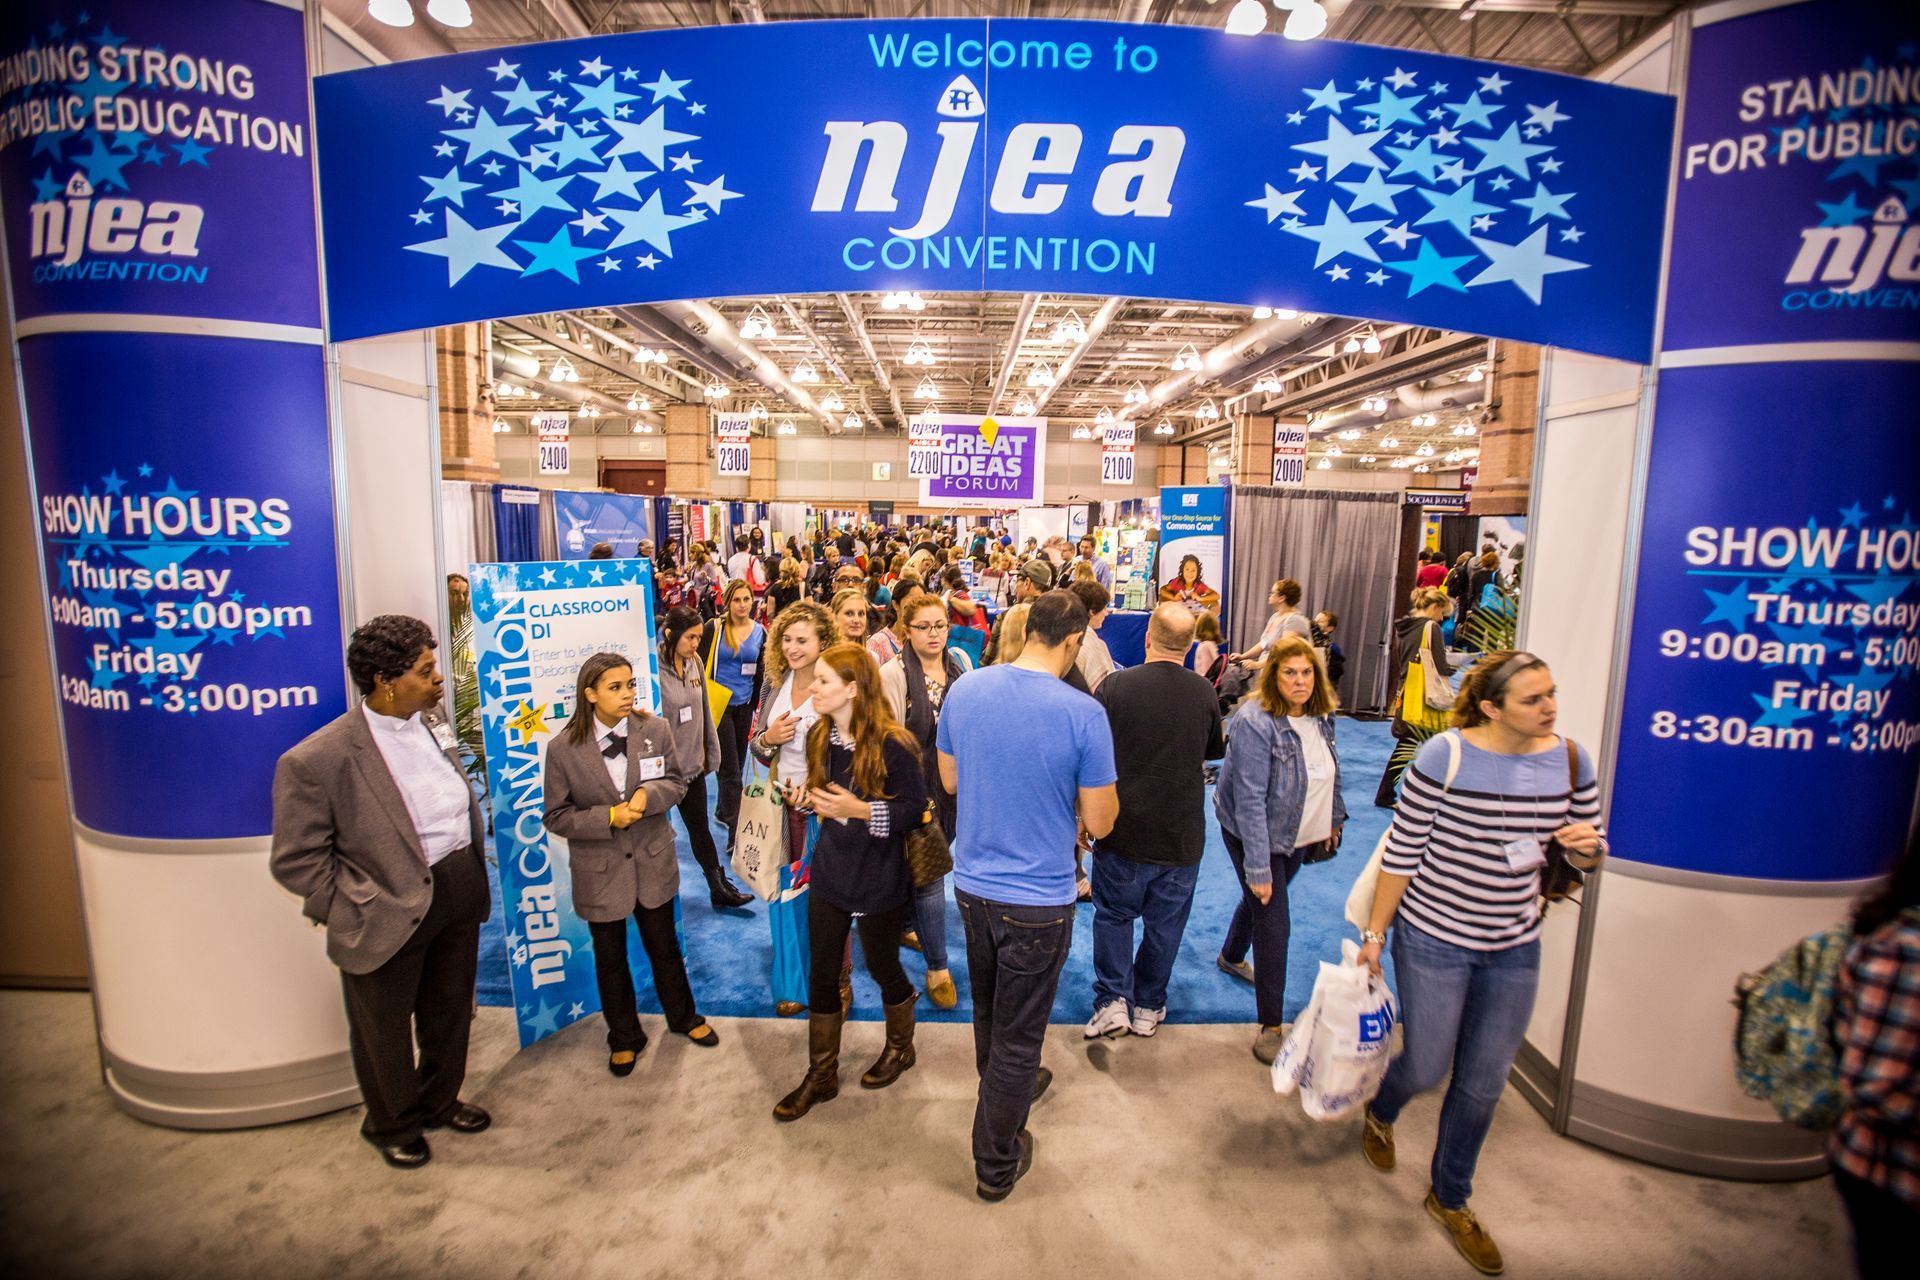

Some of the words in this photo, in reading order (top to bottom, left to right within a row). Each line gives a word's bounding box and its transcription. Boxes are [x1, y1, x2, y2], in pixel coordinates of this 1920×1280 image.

[868, 33, 1093, 71] Welcome
[1113, 36, 1158, 73] to
[99, 45, 255, 100] STRONG
[8, 95, 87, 141] PUBLIC
[93, 95, 304, 157] EDUCATION
[810, 74, 1187, 240] njea
[1684, 134, 1768, 179] FOR
[1779, 118, 1919, 165] PUBLIC
[30, 170, 204, 267] njea
[842, 236, 1156, 275] CONVENTION
[33, 261, 209, 284] CONVENTION
[540, 416, 567, 432] njea
[720, 416, 748, 432] njea
[1104, 425, 1133, 441] njea
[1277, 428, 1305, 444] njea
[540, 446, 567, 470] 2400
[720, 447, 748, 471] 2300
[941, 432, 1028, 456] GREAT
[910, 450, 939, 475] 2200
[941, 454, 1022, 478] IDEAS
[1103, 456, 1132, 480] 2100
[1275, 458, 1303, 482] 2000
[944, 476, 1018, 491] FORUM
[43, 495, 112, 535] SHOW
[123, 496, 292, 537] HOURS
[1166, 521, 1195, 531] Common
[1684, 526, 1847, 568] SHOW
[67, 560, 231, 597] Thursday
[51, 595, 121, 629] 9:00am
[155, 601, 312, 635] 5:00pm
[529, 598, 630, 618] CLASSROOM
[1747, 593, 1920, 632] Thursday
[531, 622, 551, 640] DI
[93, 644, 203, 680] Friday
[532, 649, 560, 663] Enter
[563, 648, 576, 658] to
[579, 643, 593, 656] left
[597, 642, 608, 652] of
[610, 641, 628, 653] the
[1660, 629, 1826, 665] 9:00am
[1864, 636, 1920, 671] 5:00
[163, 683, 318, 715] 3:00pm
[1771, 681, 1892, 718] Friday
[1650, 711, 1814, 750] 8:30am
[512, 881, 572, 990] njea
